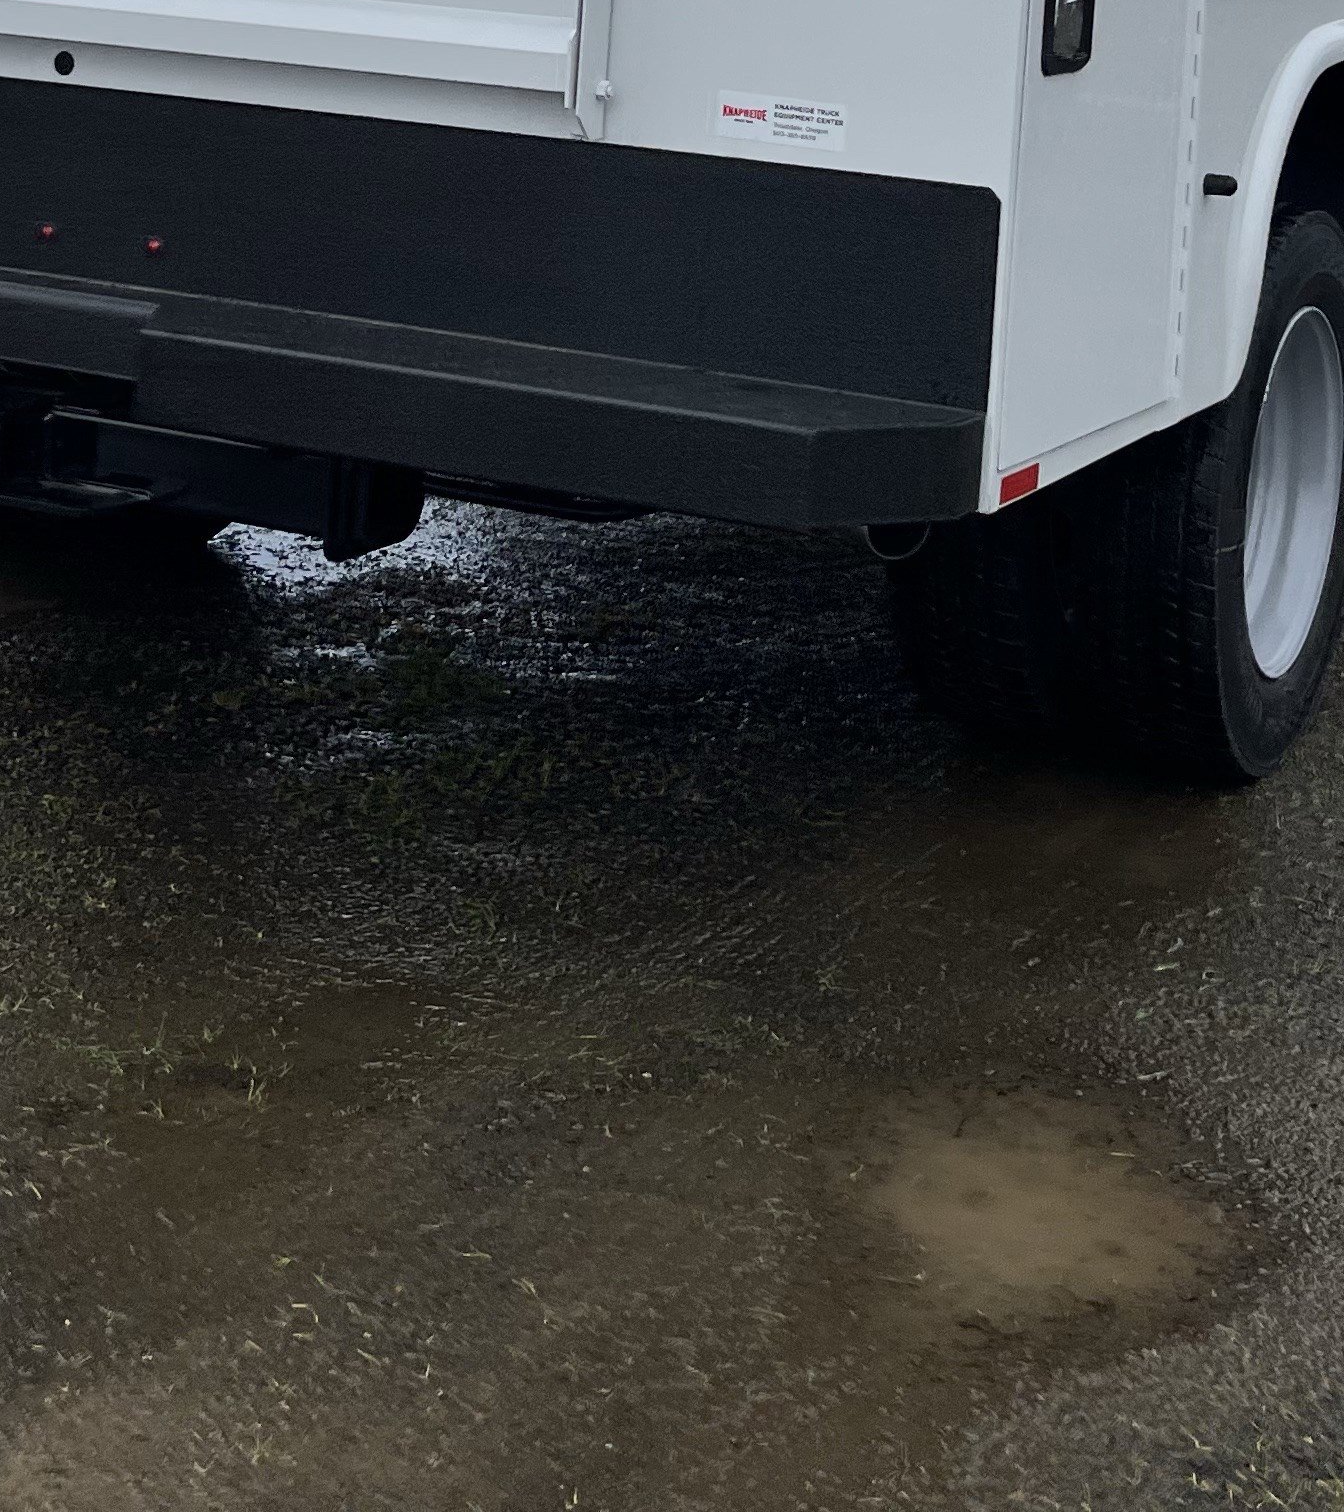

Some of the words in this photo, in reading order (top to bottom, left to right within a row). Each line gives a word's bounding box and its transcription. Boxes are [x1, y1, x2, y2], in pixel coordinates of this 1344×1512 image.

[722, 104, 768, 122] KNAPHEIDE
[774, 112, 815, 122] EQUIPMENT
[816, 117, 844, 126] CENTER
[817, 108, 840, 117] TRUCK
